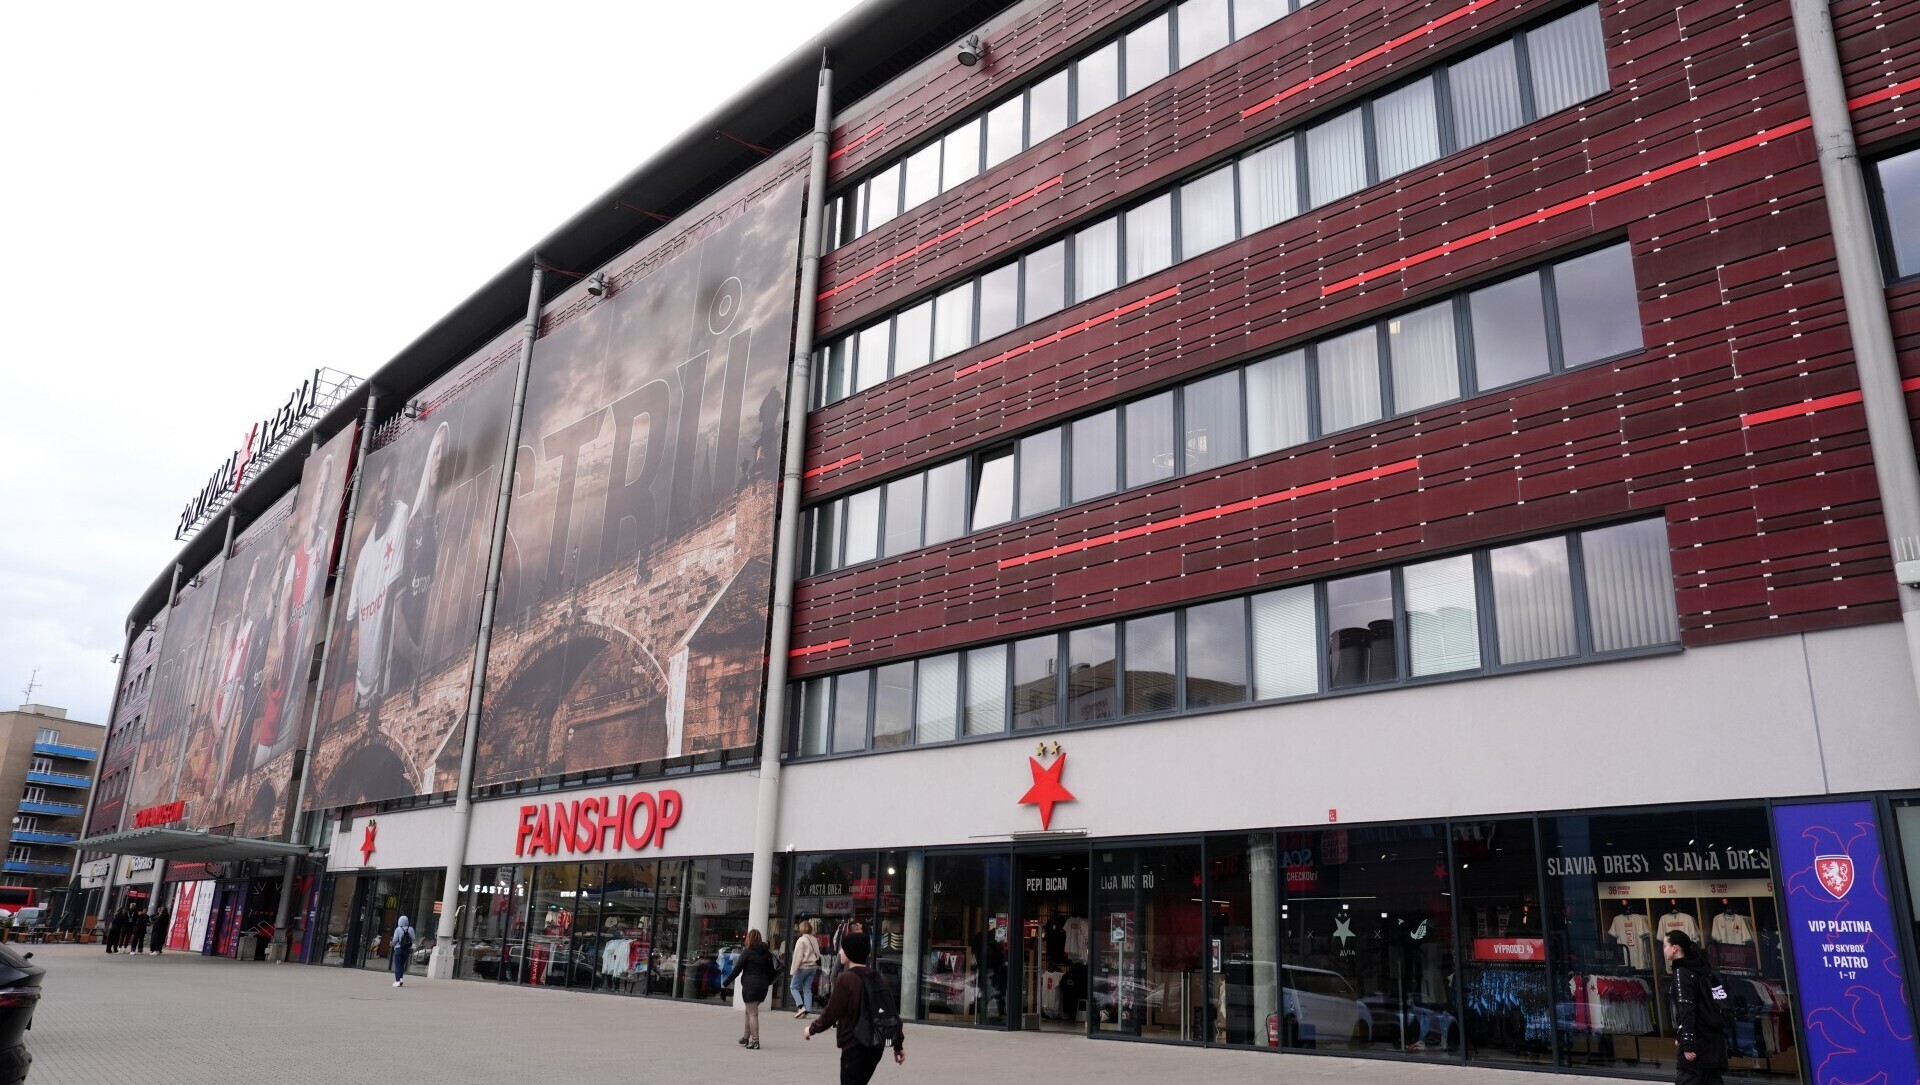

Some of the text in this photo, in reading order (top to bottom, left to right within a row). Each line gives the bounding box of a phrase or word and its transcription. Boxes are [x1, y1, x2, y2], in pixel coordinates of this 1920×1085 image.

[249, 368, 320, 464] ARENA
[515, 790, 683, 857] FANSHOP
[1547, 856, 1598, 877] SLAVIA
[1603, 853, 1650, 874] DRESY
[1663, 851, 1721, 873] SLAVIA
[1026, 877, 1068, 892] PEPI BICAN
[1121, 871, 1155, 890] MISRŮ
[474, 884, 525, 897] CASTOE
[1807, 920, 1873, 933] VIP PLATINA
[1493, 942, 1525, 954] VÝPRODEJ
[1821, 943, 1865, 953] VIP SKYBOX
[1822, 955, 1869, 969] 1. PATRO
